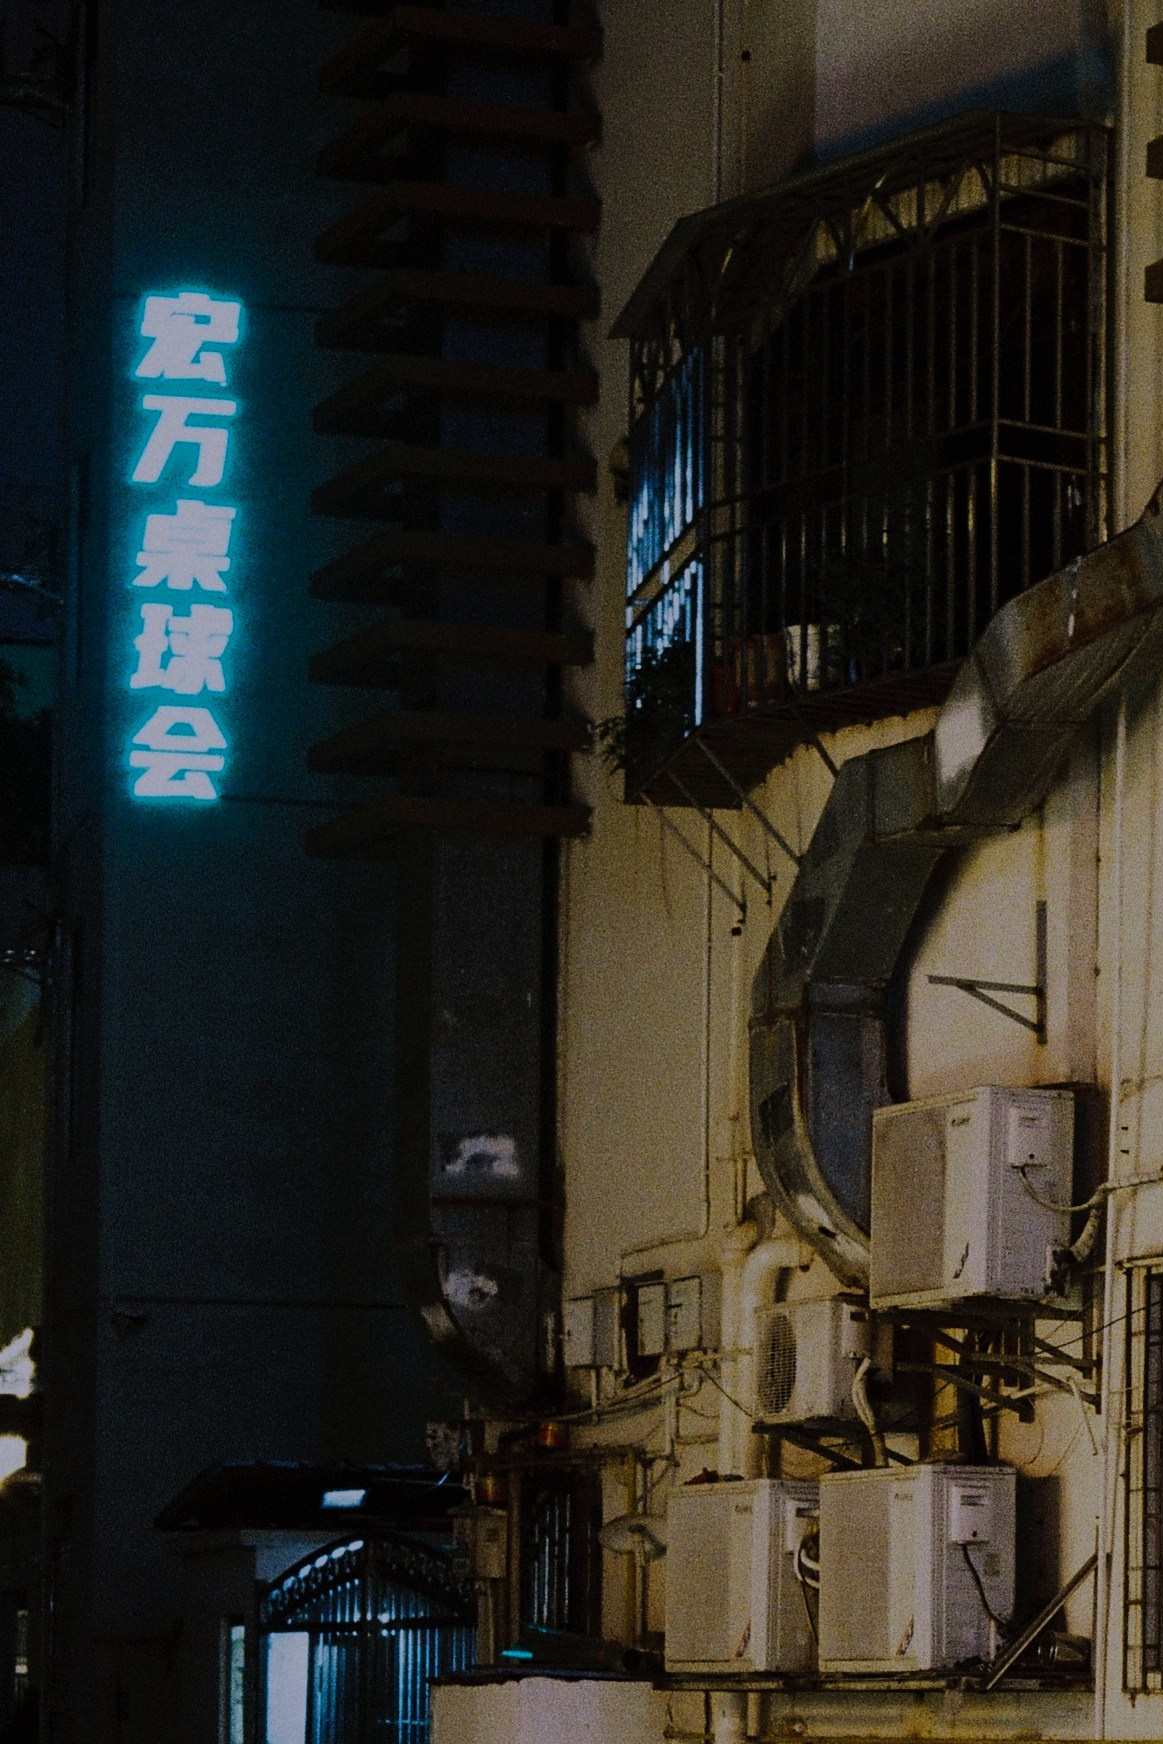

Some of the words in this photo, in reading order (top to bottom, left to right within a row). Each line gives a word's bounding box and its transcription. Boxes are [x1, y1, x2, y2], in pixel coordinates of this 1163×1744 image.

[130, 291, 242, 801] 宏万桌球会
